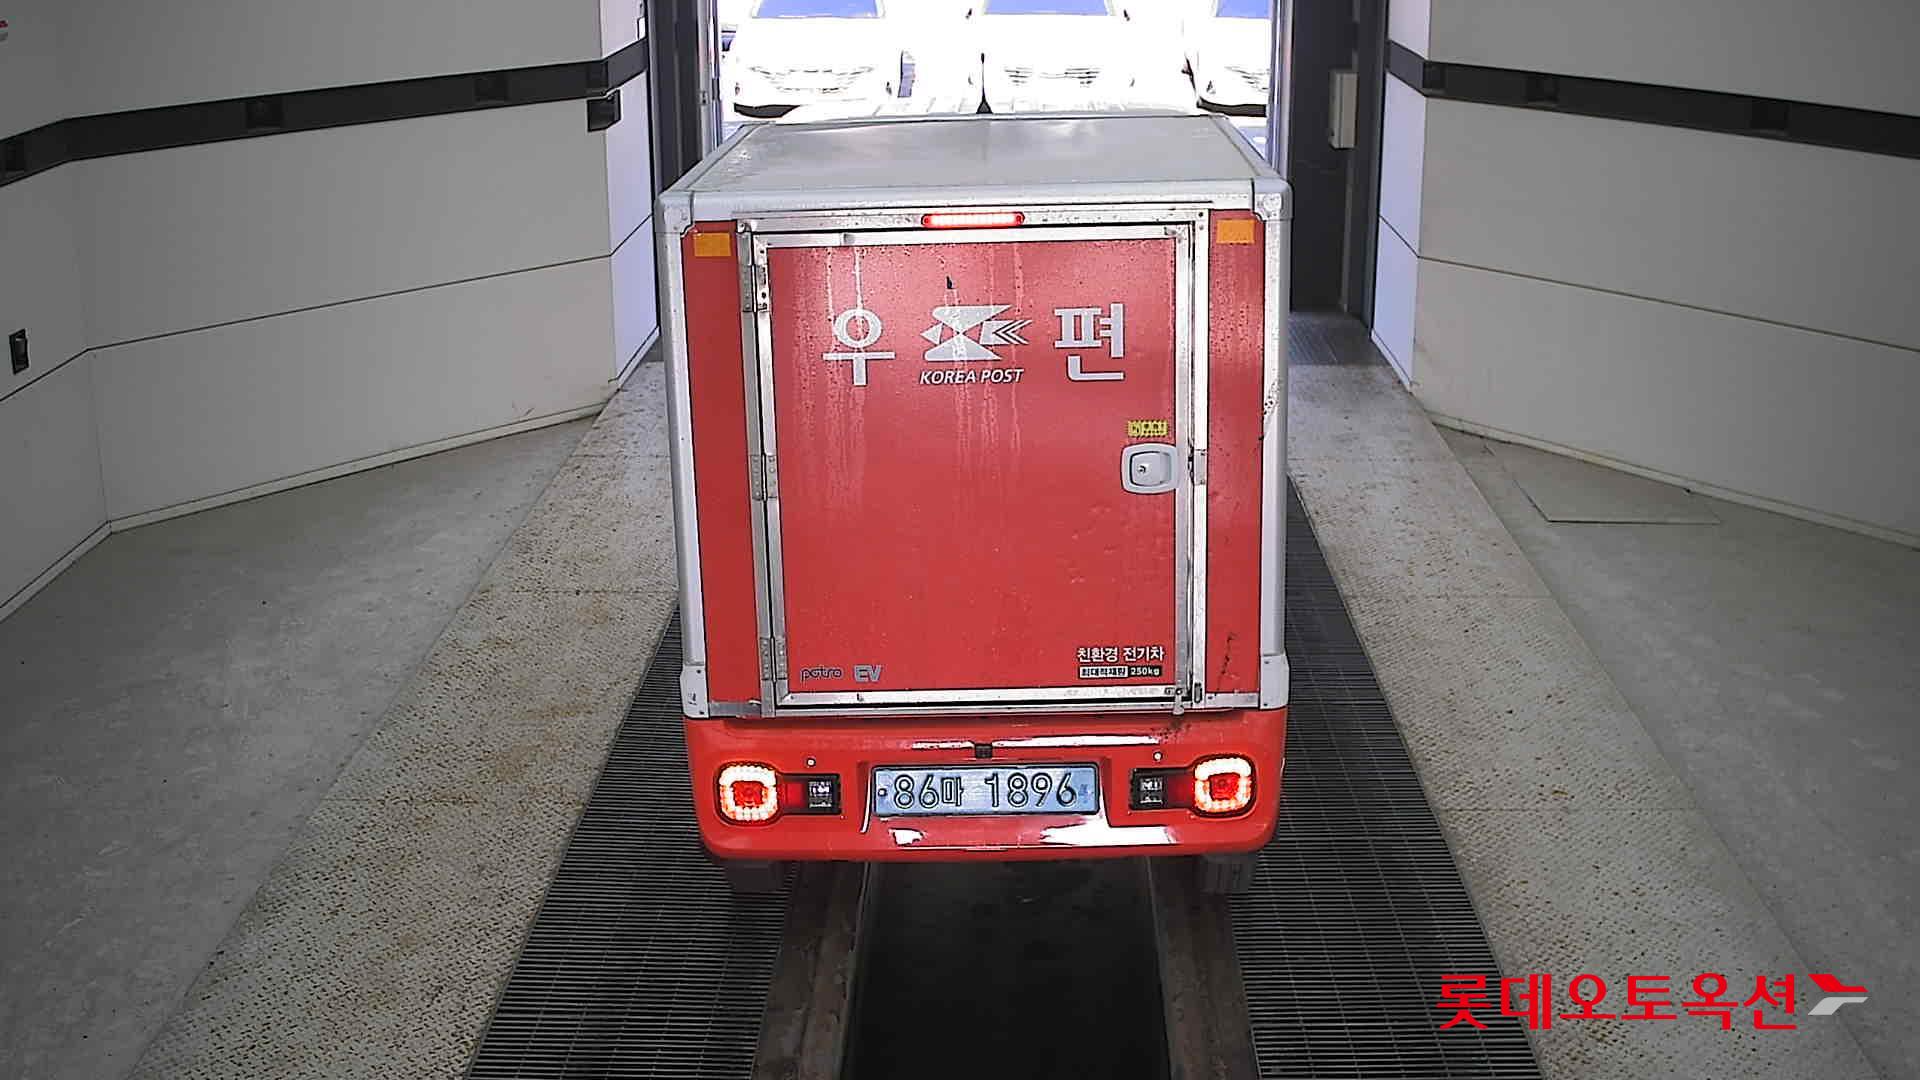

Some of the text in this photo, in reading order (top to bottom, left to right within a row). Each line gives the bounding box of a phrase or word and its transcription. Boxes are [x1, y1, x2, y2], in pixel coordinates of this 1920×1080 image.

[822, 302, 1125, 387] 우 편
[919, 368, 1025, 386] KOREA POST
[1077, 645, 1165, 663] 친환경 전기차
[855, 665, 882, 682] EV
[1130, 666, 1160, 677] 250kg
[893, 773, 965, 810] 86마
[984, 771, 1078, 808] 1896
